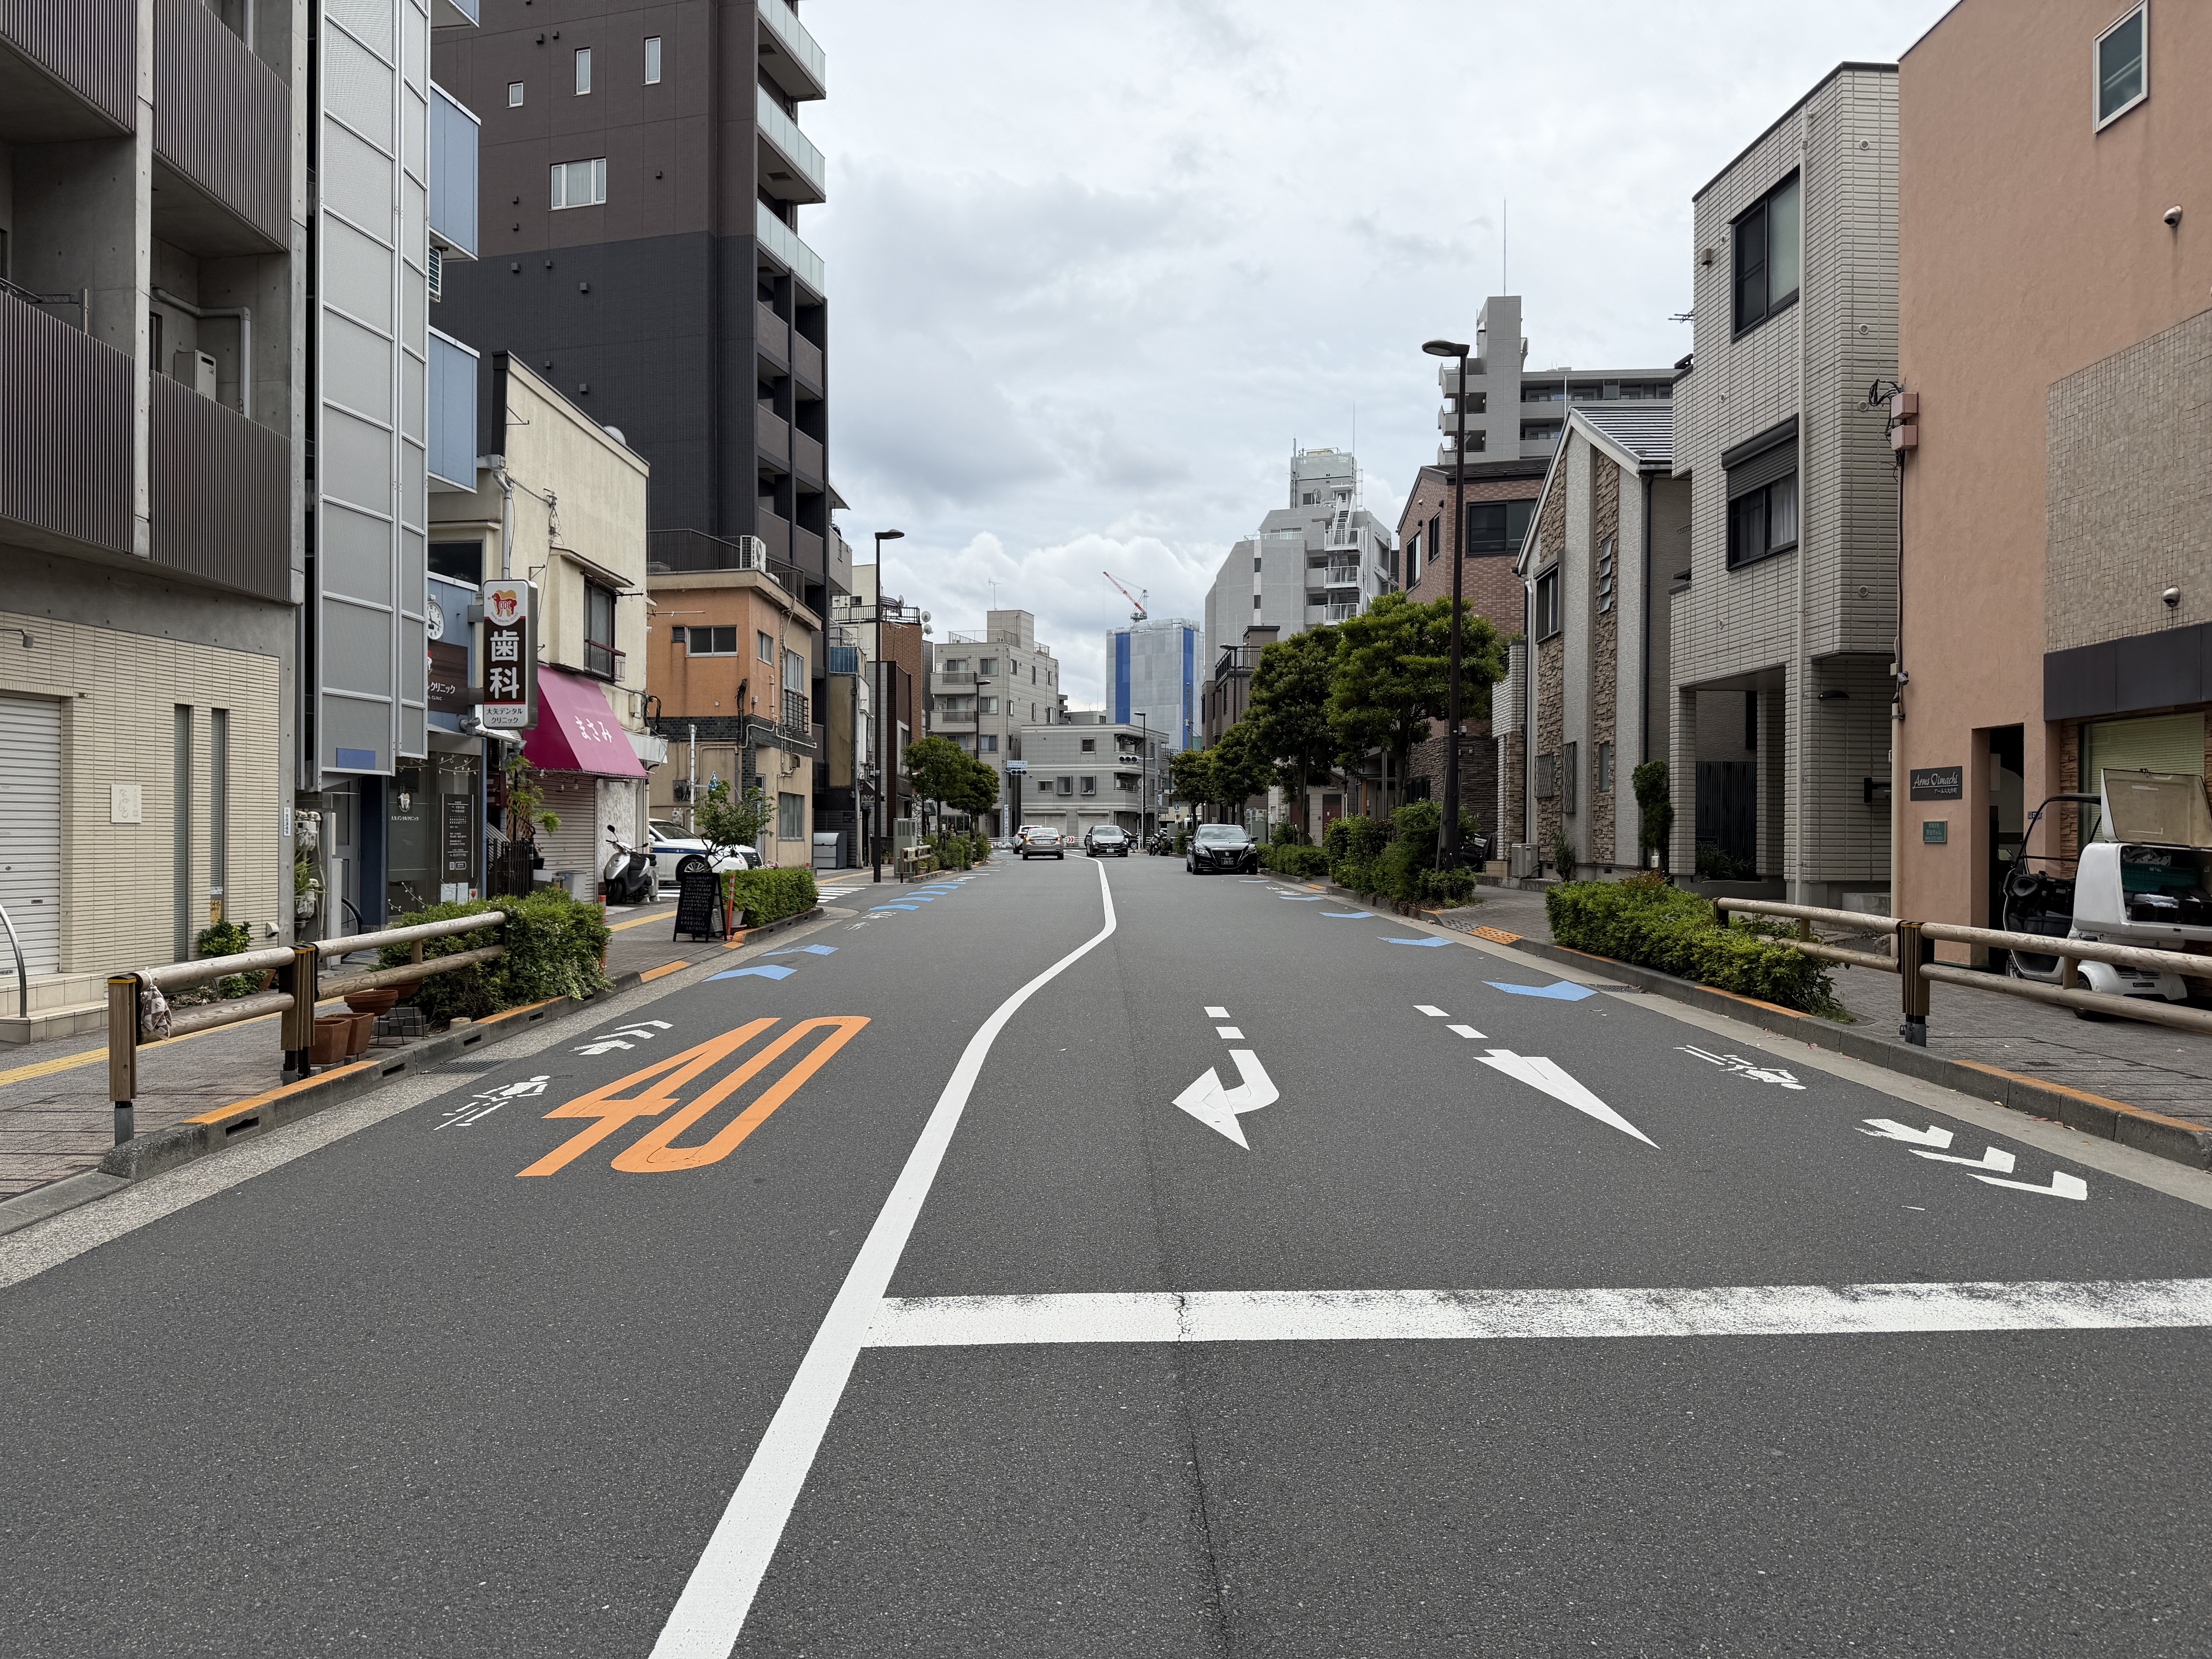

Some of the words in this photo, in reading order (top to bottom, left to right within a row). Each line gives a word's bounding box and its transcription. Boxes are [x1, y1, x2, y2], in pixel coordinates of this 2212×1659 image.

[499, 601, 512, 610] ODC
[490, 630, 519, 699] 歯科
[575, 716, 612, 743] まさみ
[1914, 774, 1930, 789] Arms
[1931, 772, 1958, 786] Oimachi
[515, 1016, 871, 1176] 40
